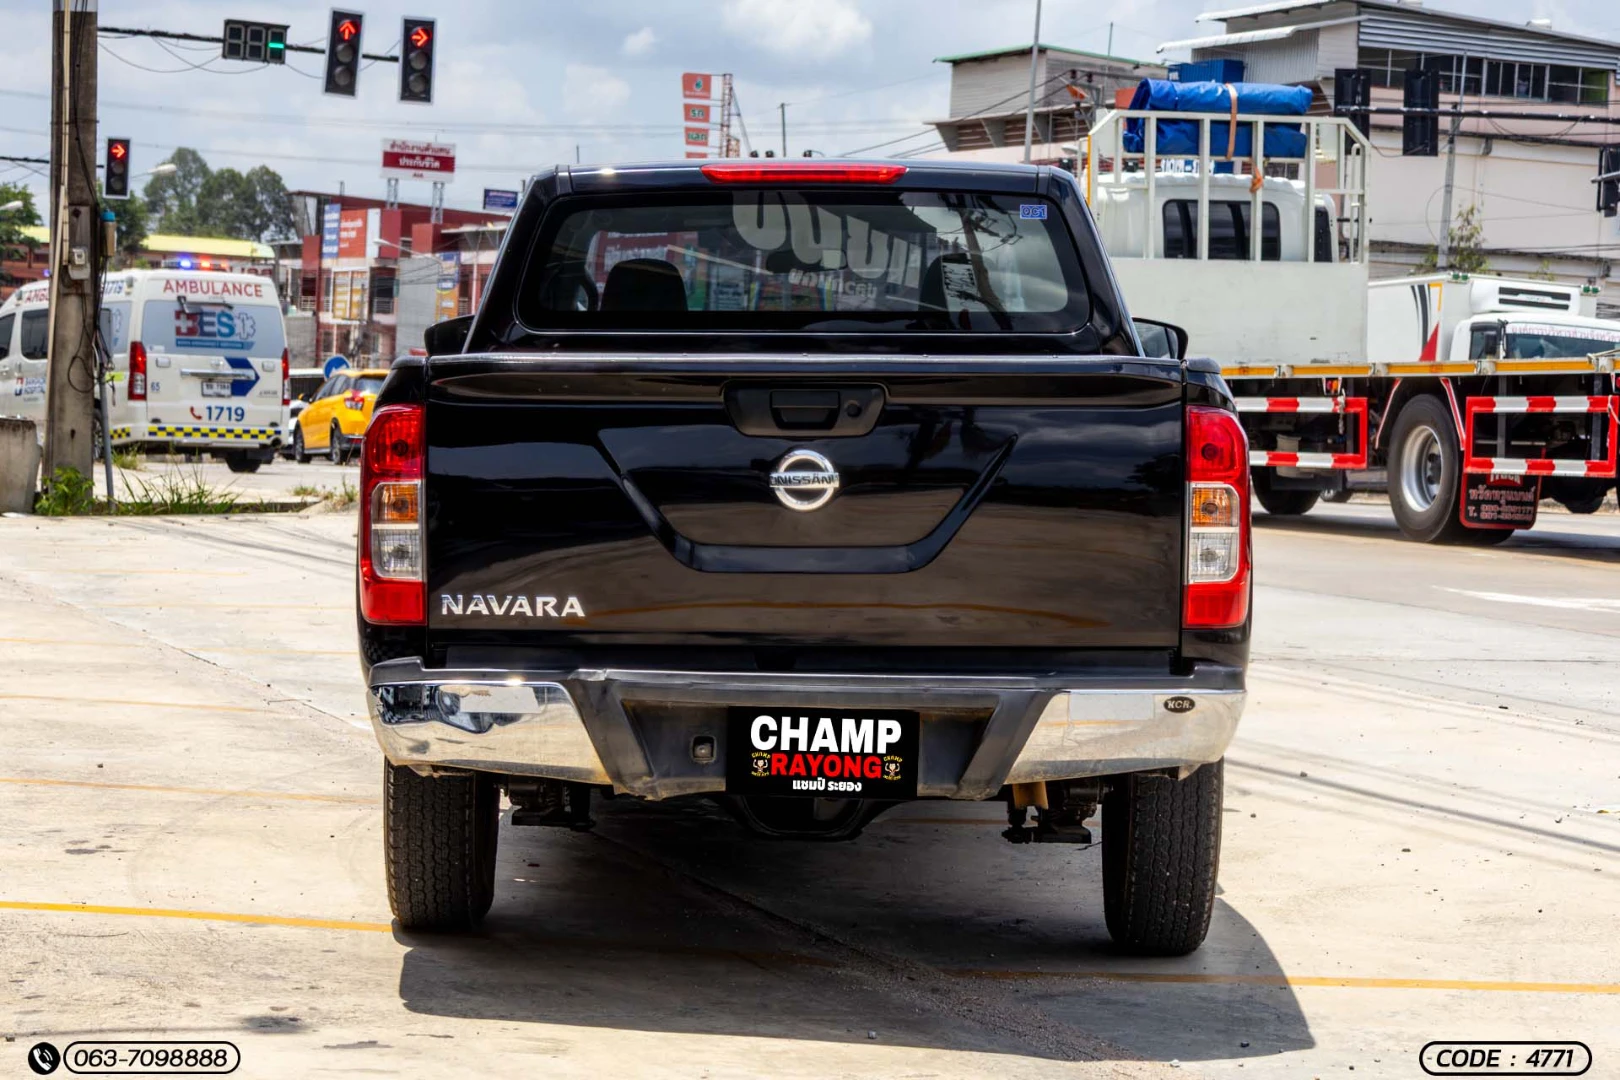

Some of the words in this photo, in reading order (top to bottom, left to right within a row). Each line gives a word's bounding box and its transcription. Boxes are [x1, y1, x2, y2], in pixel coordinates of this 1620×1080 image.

[163, 280, 263, 298] AMBULANCE
[151, 382, 160, 391] 65
[206, 405, 245, 422] 1719
[777, 474, 832, 486] NISSAN
[441, 594, 586, 617] NAVARA
[750, 715, 902, 754] CHAMP
[771, 753, 883, 779] RAYONG
[827, 780, 862, 792] ระยอง
